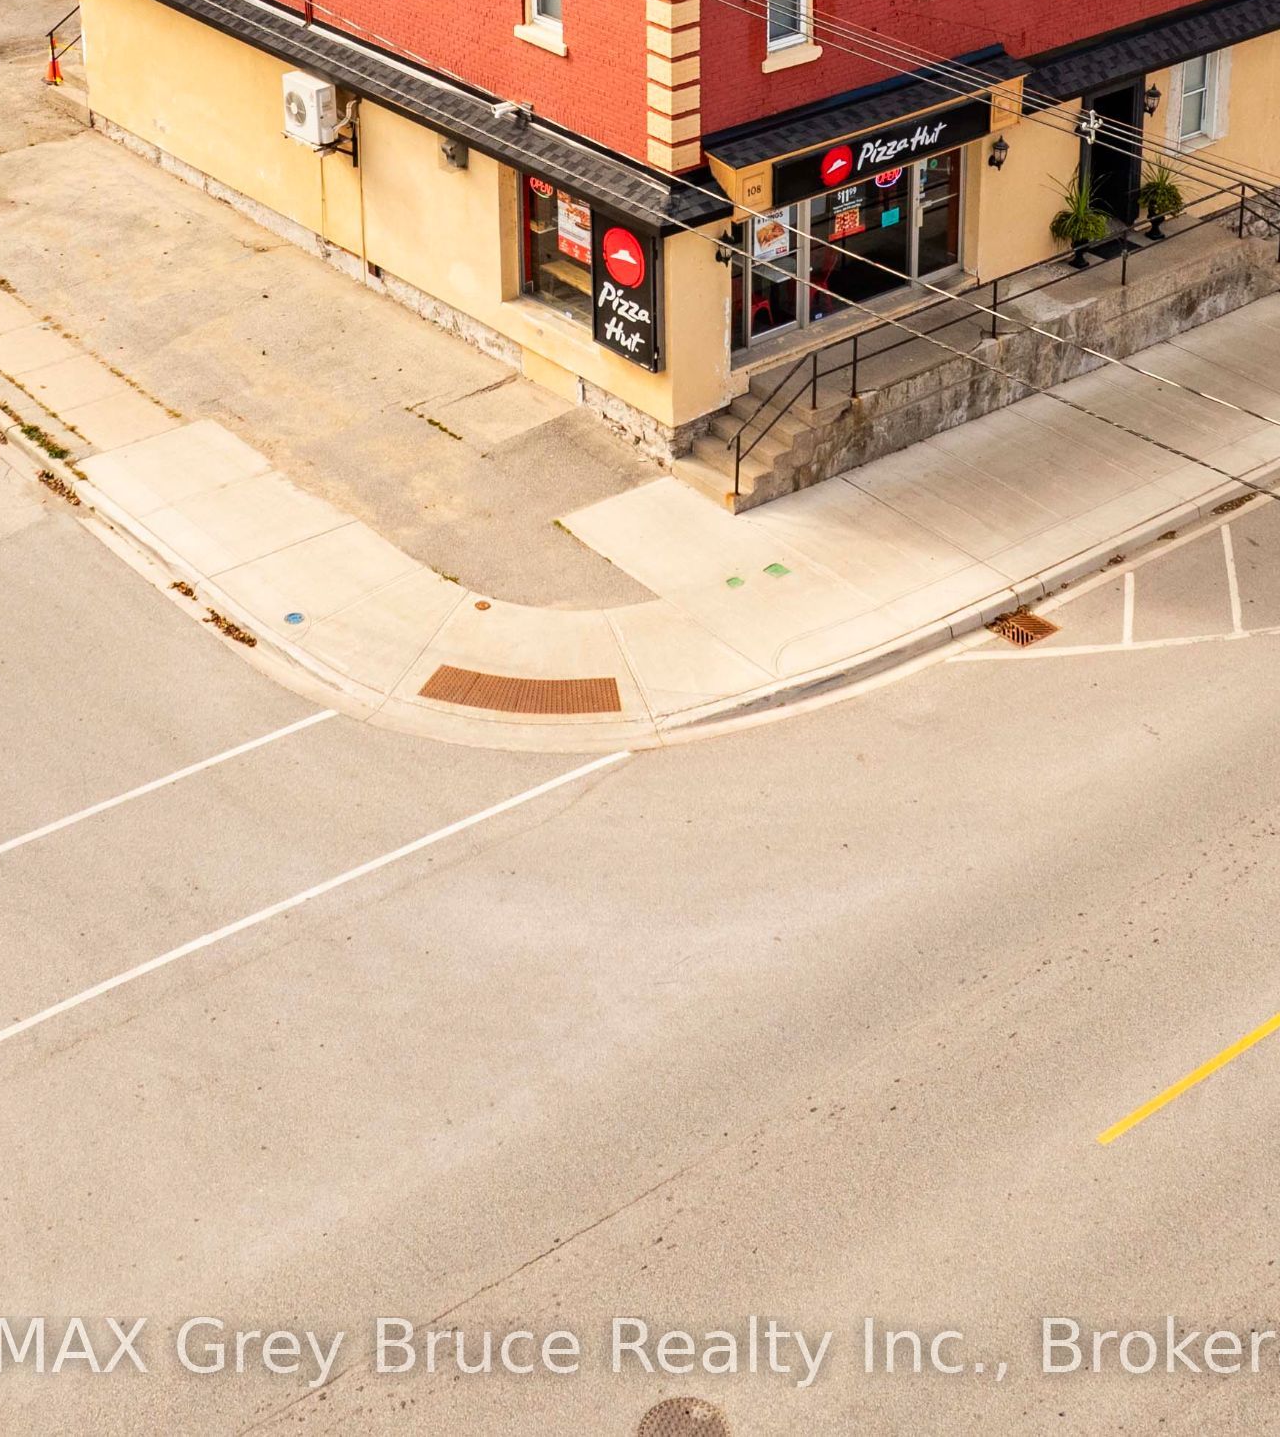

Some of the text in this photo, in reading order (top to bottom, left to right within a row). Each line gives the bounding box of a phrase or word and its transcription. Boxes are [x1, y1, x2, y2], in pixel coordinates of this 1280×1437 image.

[857, 122, 947, 171] Pizza Hut
[530, 176, 553, 196] OPEN
[747, 185, 762, 197] 108
[598, 281, 650, 324] Pizza
[604, 316, 645, 352] Hut
